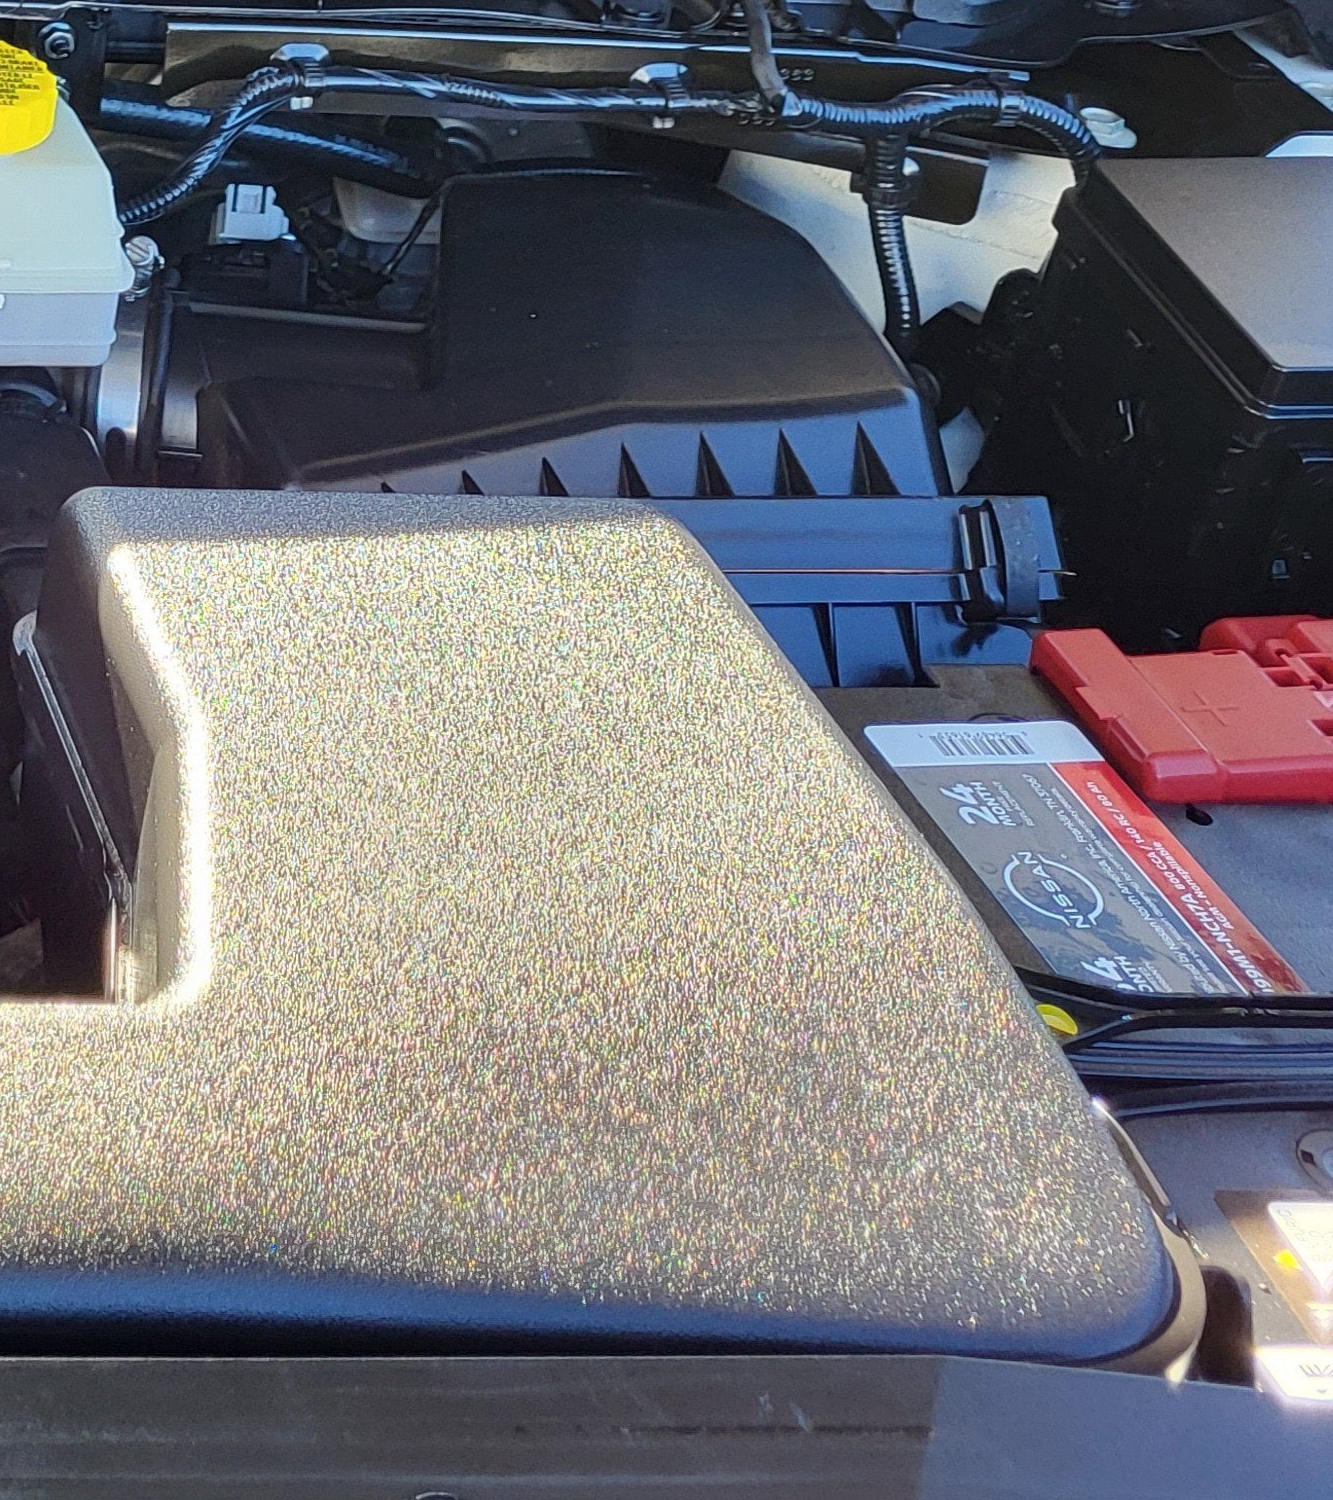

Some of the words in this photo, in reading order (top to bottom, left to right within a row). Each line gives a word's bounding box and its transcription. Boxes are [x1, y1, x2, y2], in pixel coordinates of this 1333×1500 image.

[1082, 781, 1103, 793] Ah
[934, 783, 1001, 824] 24
[968, 781, 1017, 825] MONTH
[1041, 797, 1061, 809] TN
[1110, 813, 1132, 825] RC
[1123, 827, 1147, 843] 140
[1143, 851, 1170, 869] CCA
[1147, 840, 1210, 898] Nonspillable
[1015, 850, 1093, 929] NISSAN
[1123, 894, 1155, 920] North
[1205, 906, 1236, 929] AGM
[1146, 921, 1180, 950] Nissan
[1170, 950, 1193, 963] by
